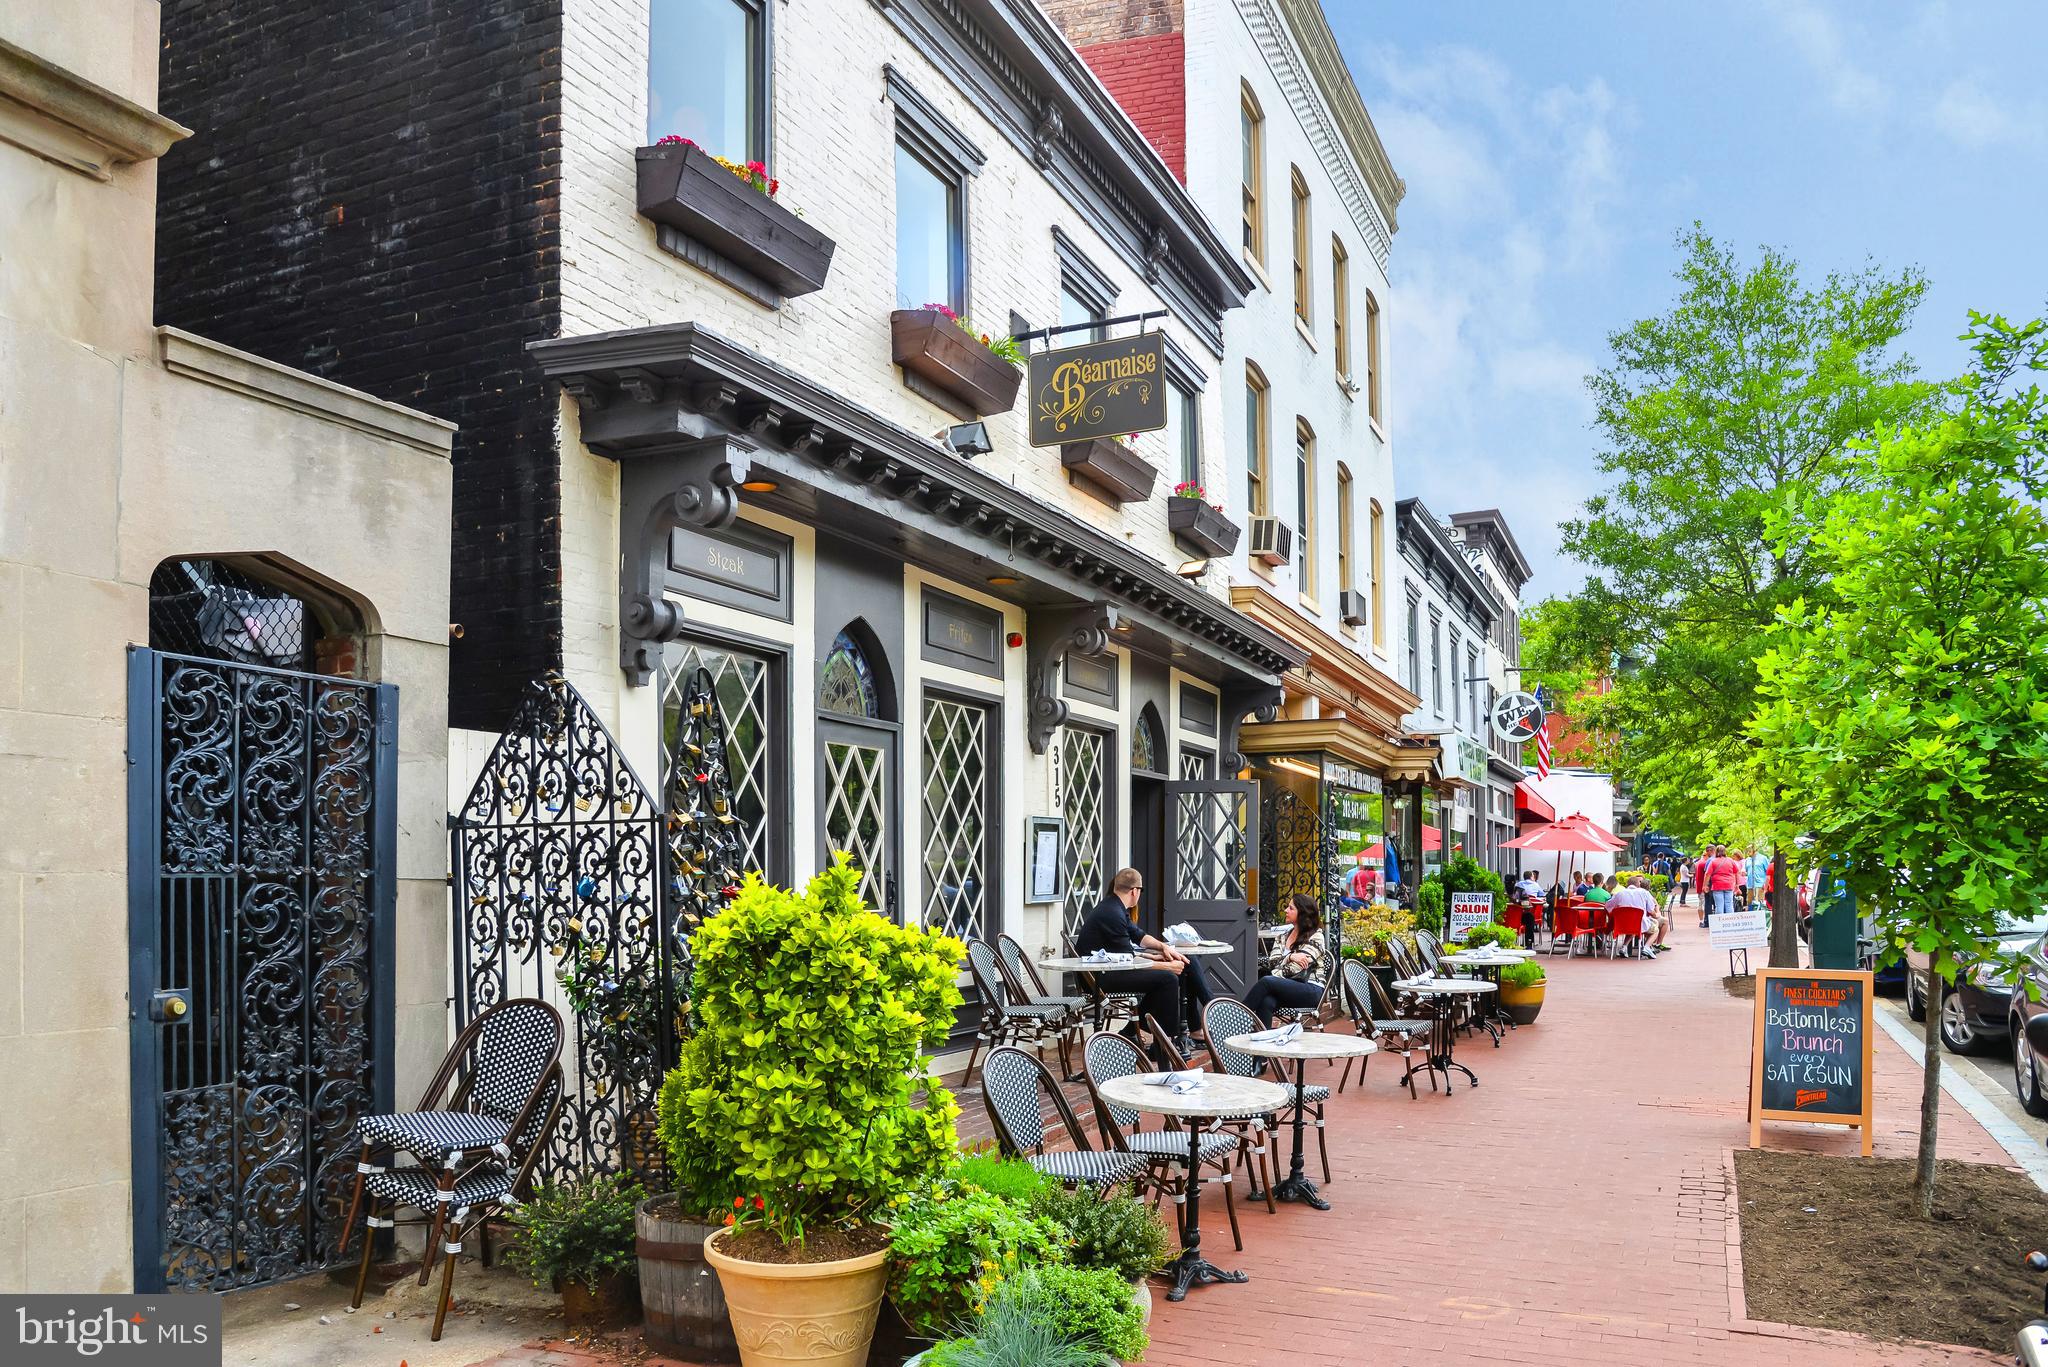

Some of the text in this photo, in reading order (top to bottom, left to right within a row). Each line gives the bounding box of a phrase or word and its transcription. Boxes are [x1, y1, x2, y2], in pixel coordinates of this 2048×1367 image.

[1052, 348, 1156, 428] Béarnaise
[708, 547, 744, 575] Steak
[1453, 894, 1490, 903] FULL SERVICE
[1454, 904, 1489, 914] SALON
[1452, 914, 1489, 923] 202-543-2015
[1783, 987, 1847, 1001] FINEST COCKTAILS
[1767, 1008, 1857, 1034] Bottomless
[1782, 1028, 1844, 1054] Brunch
[1790, 1053, 1826, 1068] every
[1767, 1063, 1800, 1083] SAT
